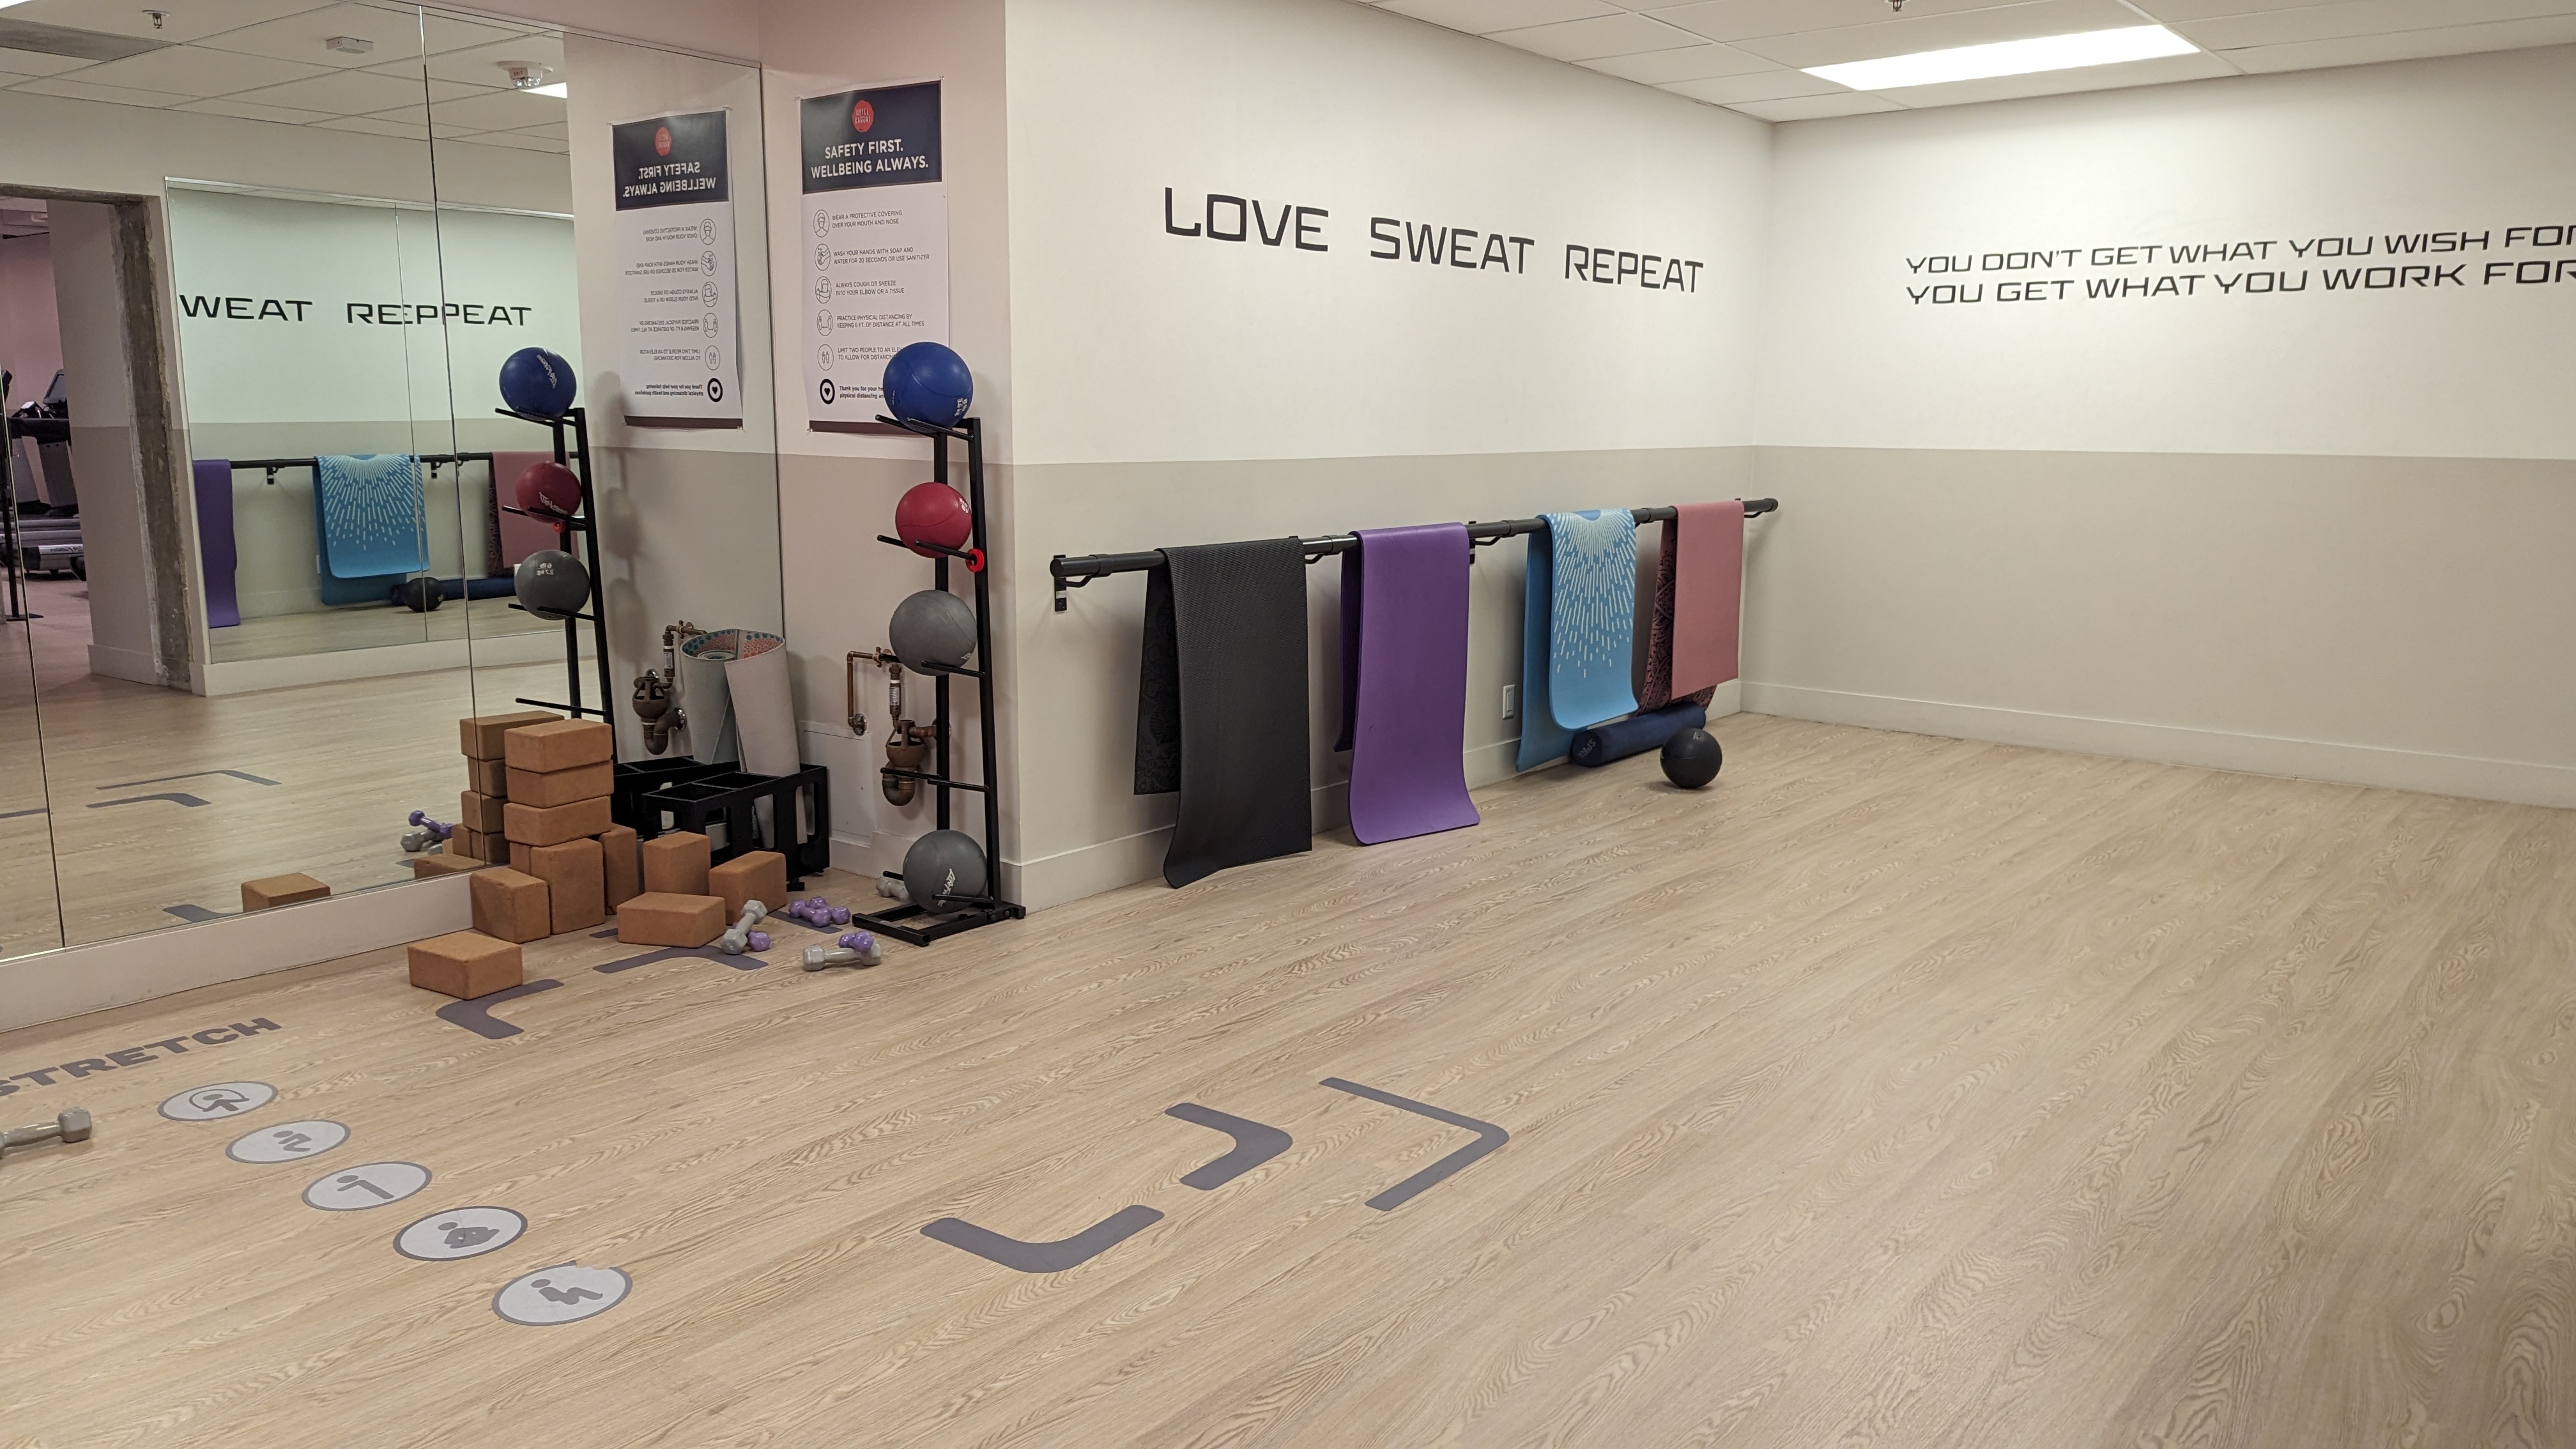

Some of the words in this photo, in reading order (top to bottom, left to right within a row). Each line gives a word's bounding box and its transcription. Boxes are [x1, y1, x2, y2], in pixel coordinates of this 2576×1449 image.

[811, 160, 872, 179] WELLBEING
[876, 155, 928, 172] ALWAYS.
[825, 142, 865, 159] SAFETY
[868, 139, 903, 154] FIRST.
[1165, 187, 1329, 252] LOVE
[1370, 217, 1535, 275] SWEAT
[1565, 243, 1703, 293] REPEAT
[1905, 255, 1972, 274] YOU
[1982, 249, 2082, 272] DON'T
[2090, 245, 2163, 266] GET
[2169, 241, 2278, 264] WHAT
[2288, 236, 2373, 257] YOU
[2384, 231, 2490, 254] WISH
[2504, 225, 2576, 248] FO
[1906, 284, 1983, 305] YOU
[1997, 280, 2074, 302] GET
[2086, 275, 2205, 299] WHAT
[2214, 270, 2308, 294] YOU
[2322, 264, 2467, 290] WORK
[2483, 259, 2576, 286] FOR
